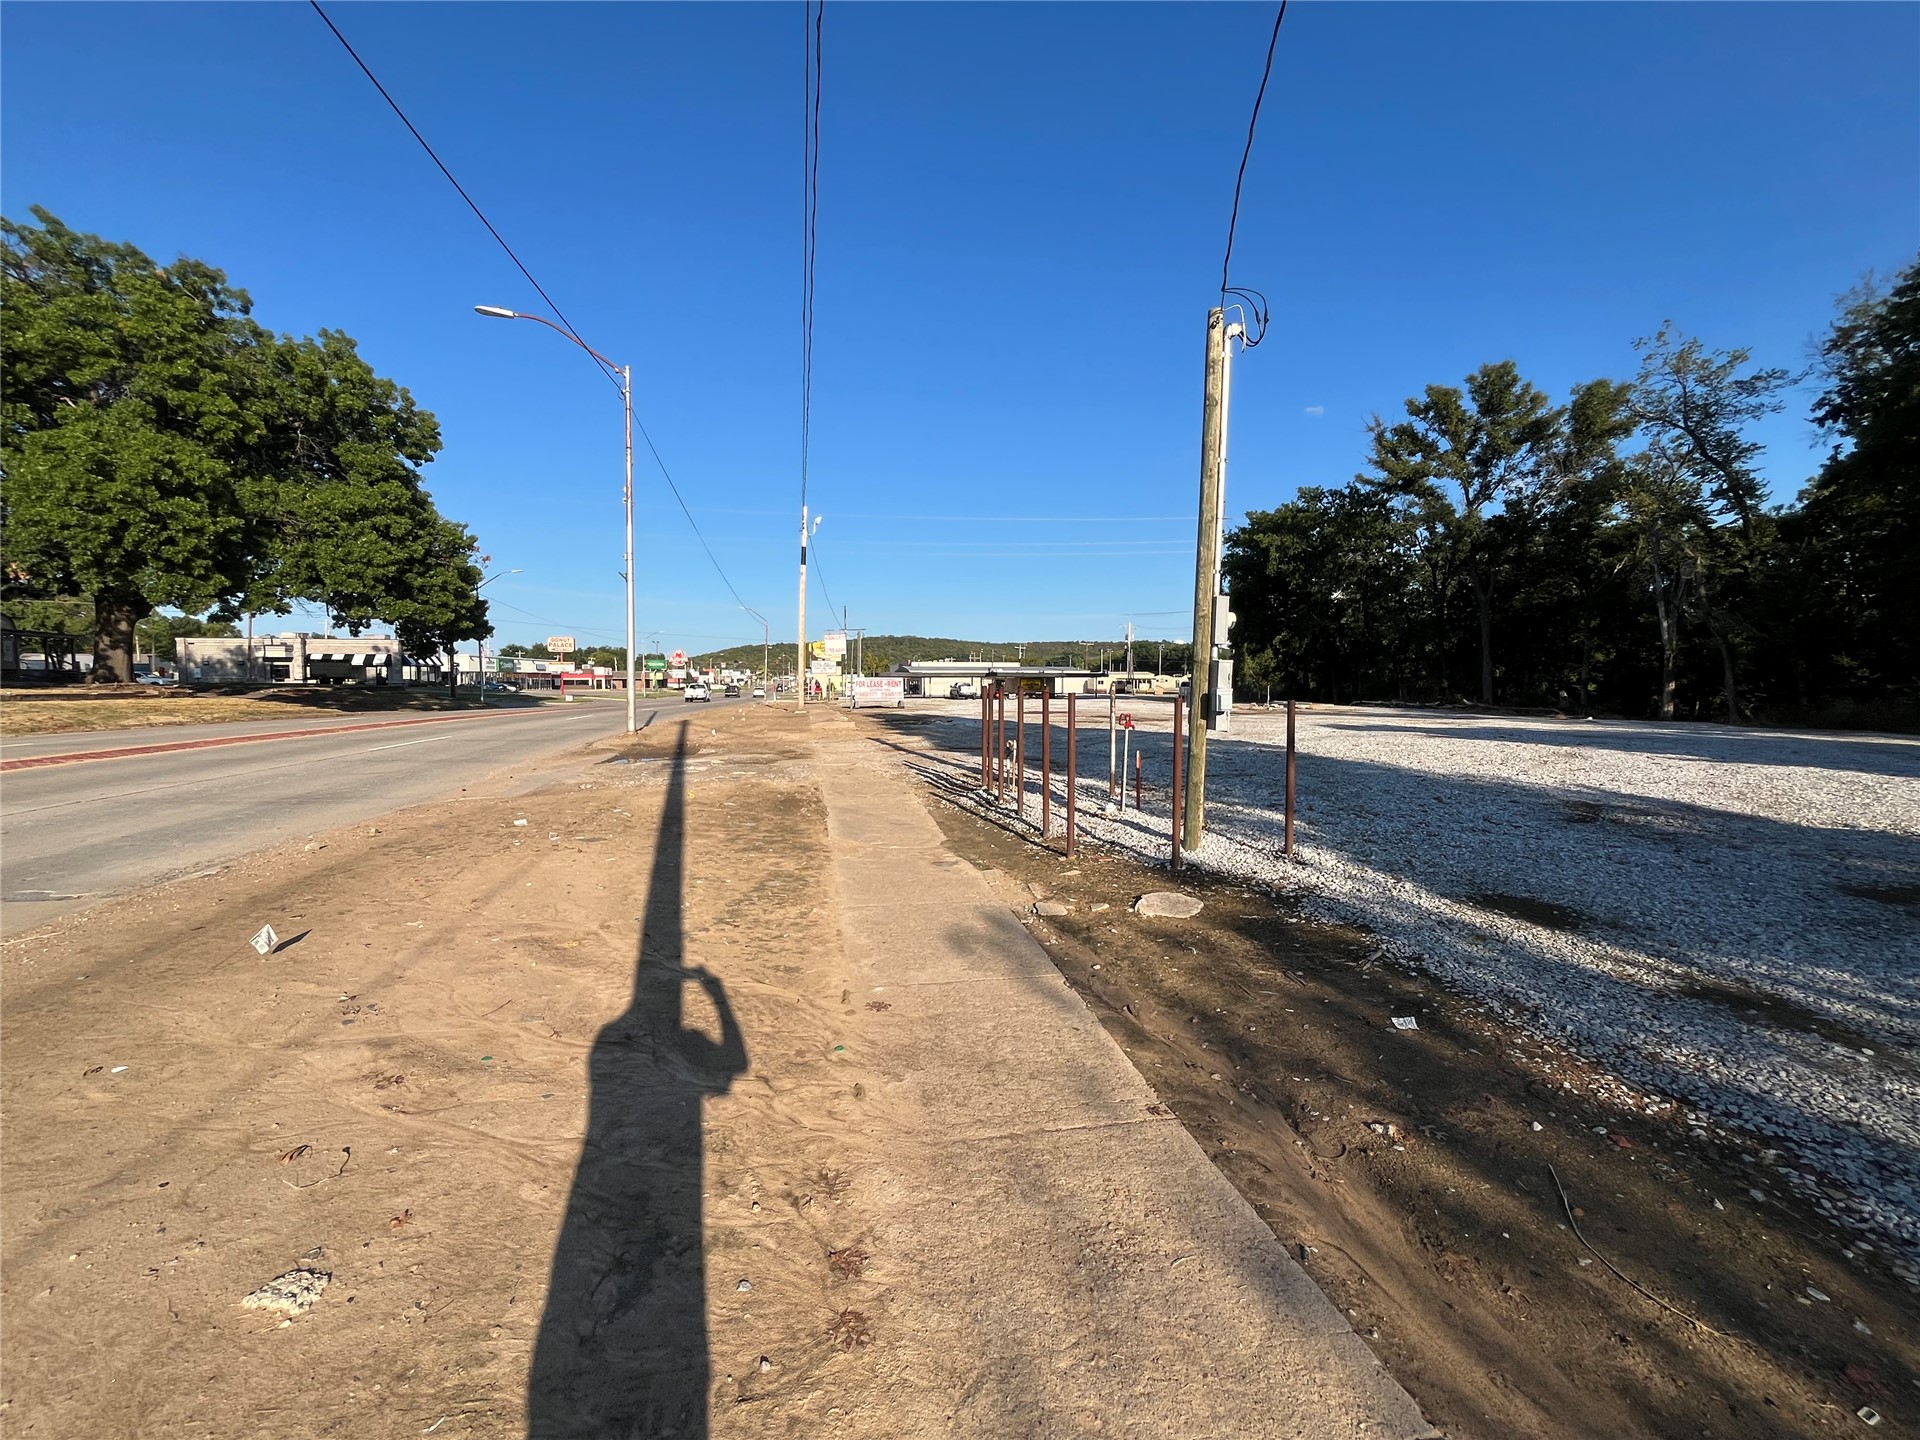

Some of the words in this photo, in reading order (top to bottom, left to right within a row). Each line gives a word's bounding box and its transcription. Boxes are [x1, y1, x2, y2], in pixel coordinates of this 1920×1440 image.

[856, 680, 865, 688] FOR
[866, 680, 883, 688] LEASE
[887, 680, 902, 688] RENT
